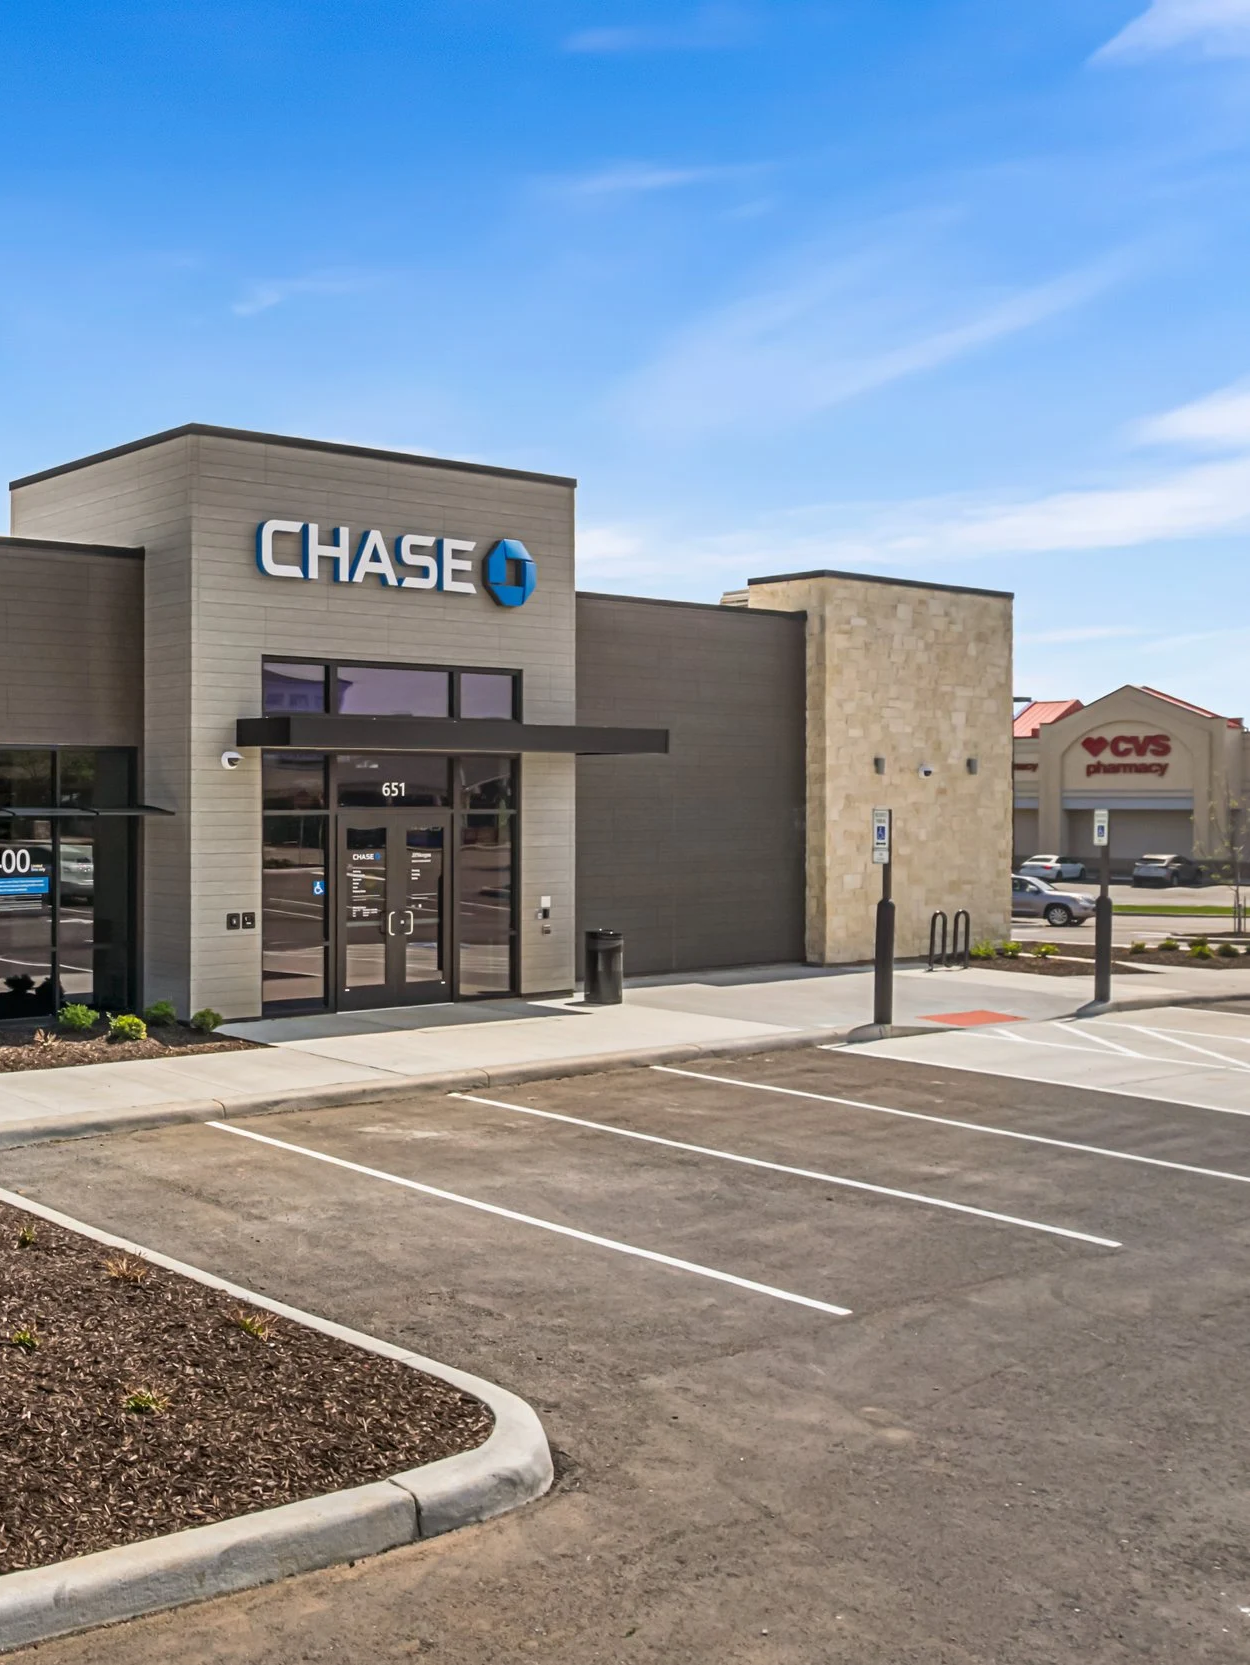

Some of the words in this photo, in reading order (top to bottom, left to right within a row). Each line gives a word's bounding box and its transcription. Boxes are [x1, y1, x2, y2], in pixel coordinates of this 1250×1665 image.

[258, 519, 477, 594] CHASE
[1110, 734, 1172, 758] CVS
[1086, 760, 1169, 778] pharmacy
[382, 782, 405, 797] 651
[352, 853, 375, 861] CHASE
